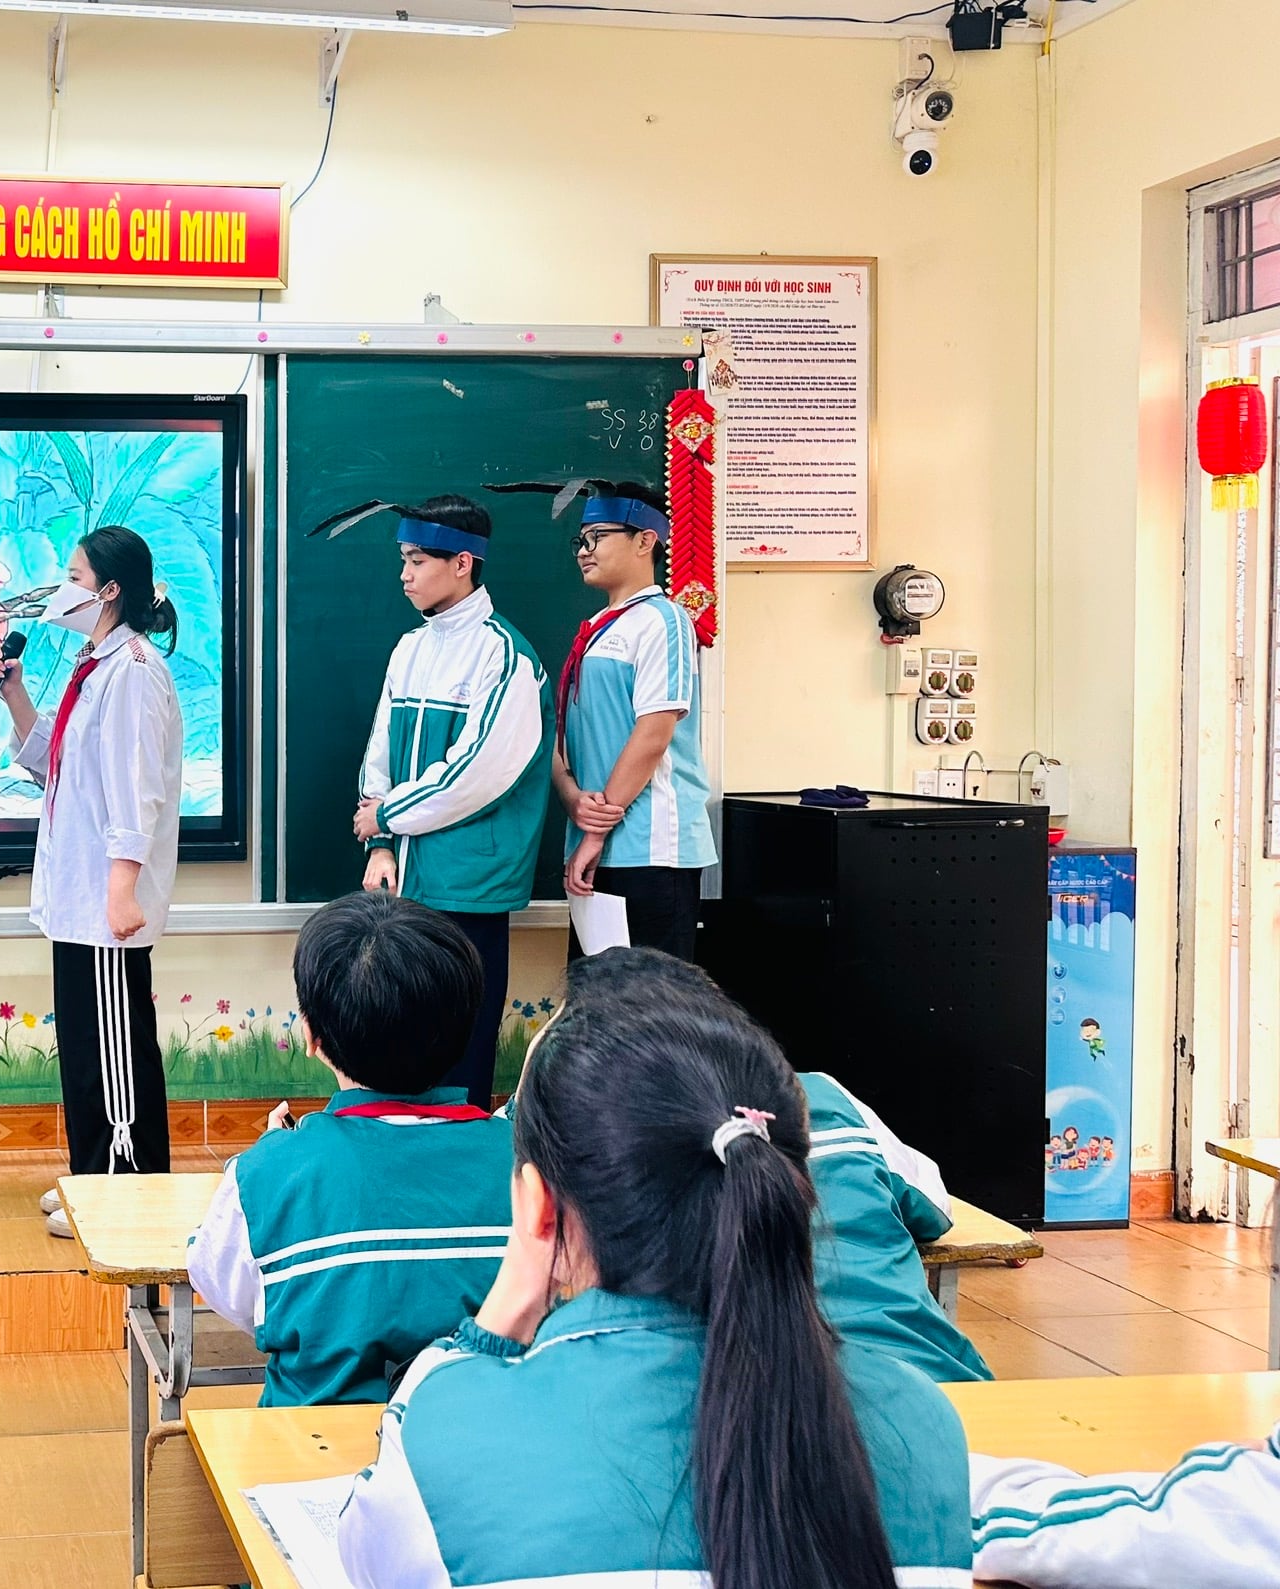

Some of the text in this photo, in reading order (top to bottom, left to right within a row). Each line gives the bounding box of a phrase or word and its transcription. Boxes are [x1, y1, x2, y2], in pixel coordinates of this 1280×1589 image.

[14, 197, 80, 260] CÁCH
[87, 191, 122, 261] HỒ
[129, 200, 173, 262] CHÍ
[179, 209, 246, 264] MINH
[694, 276, 832, 296] QUY ĐỊNH ĐỐI VỚI HỌC SINH
[601, 408, 660, 432] SS 38
[608, 434, 622, 449] V
